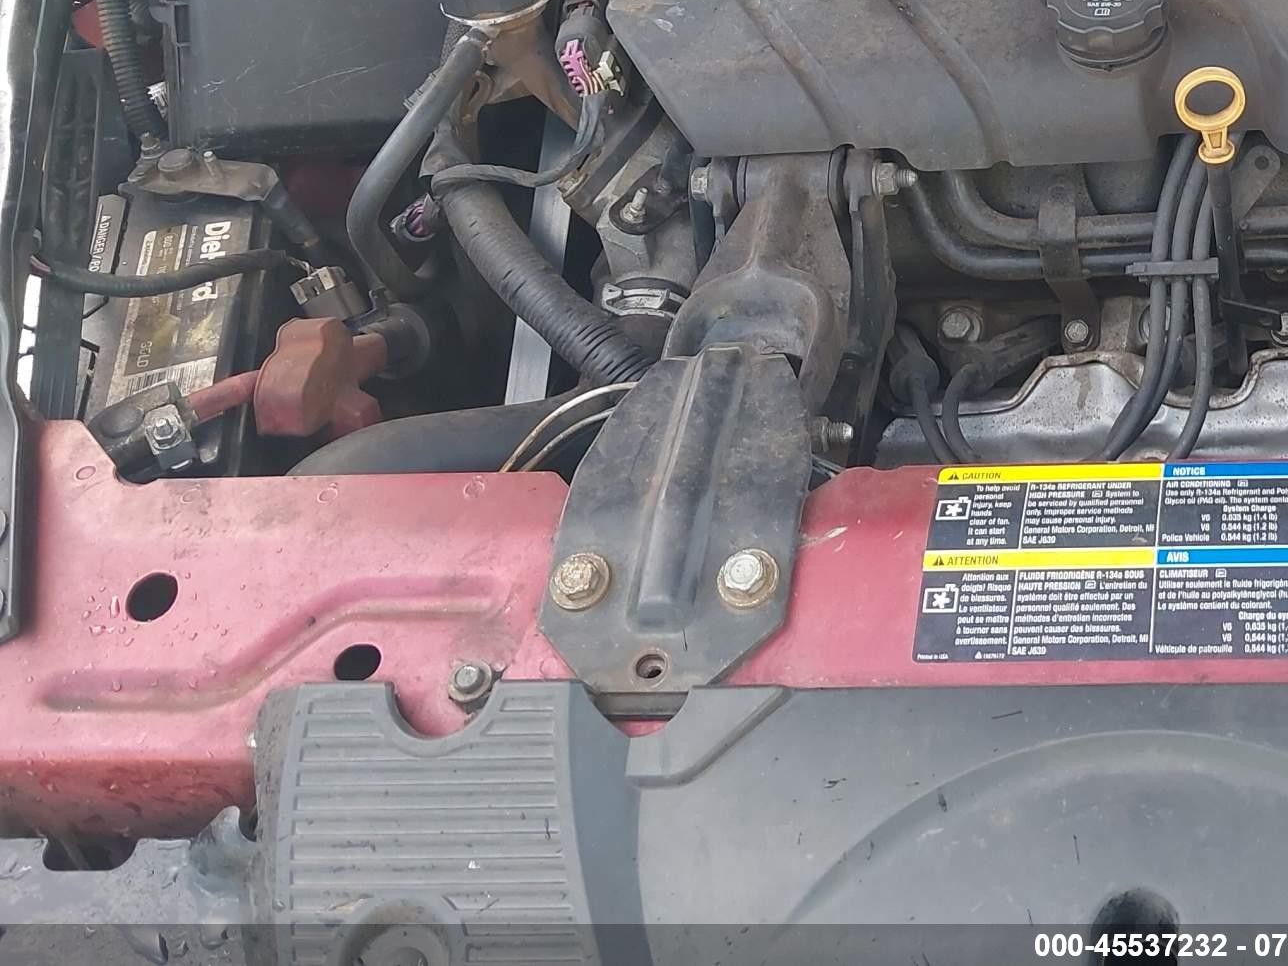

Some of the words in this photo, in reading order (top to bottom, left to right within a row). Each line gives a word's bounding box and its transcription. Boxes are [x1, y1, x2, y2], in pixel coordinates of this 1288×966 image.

[962, 472, 1001, 480] CAUTION
[1173, 467, 1205, 476] NOTICE
[947, 556, 999, 566] ATTENTION
[1166, 552, 1190, 562] AVIS
